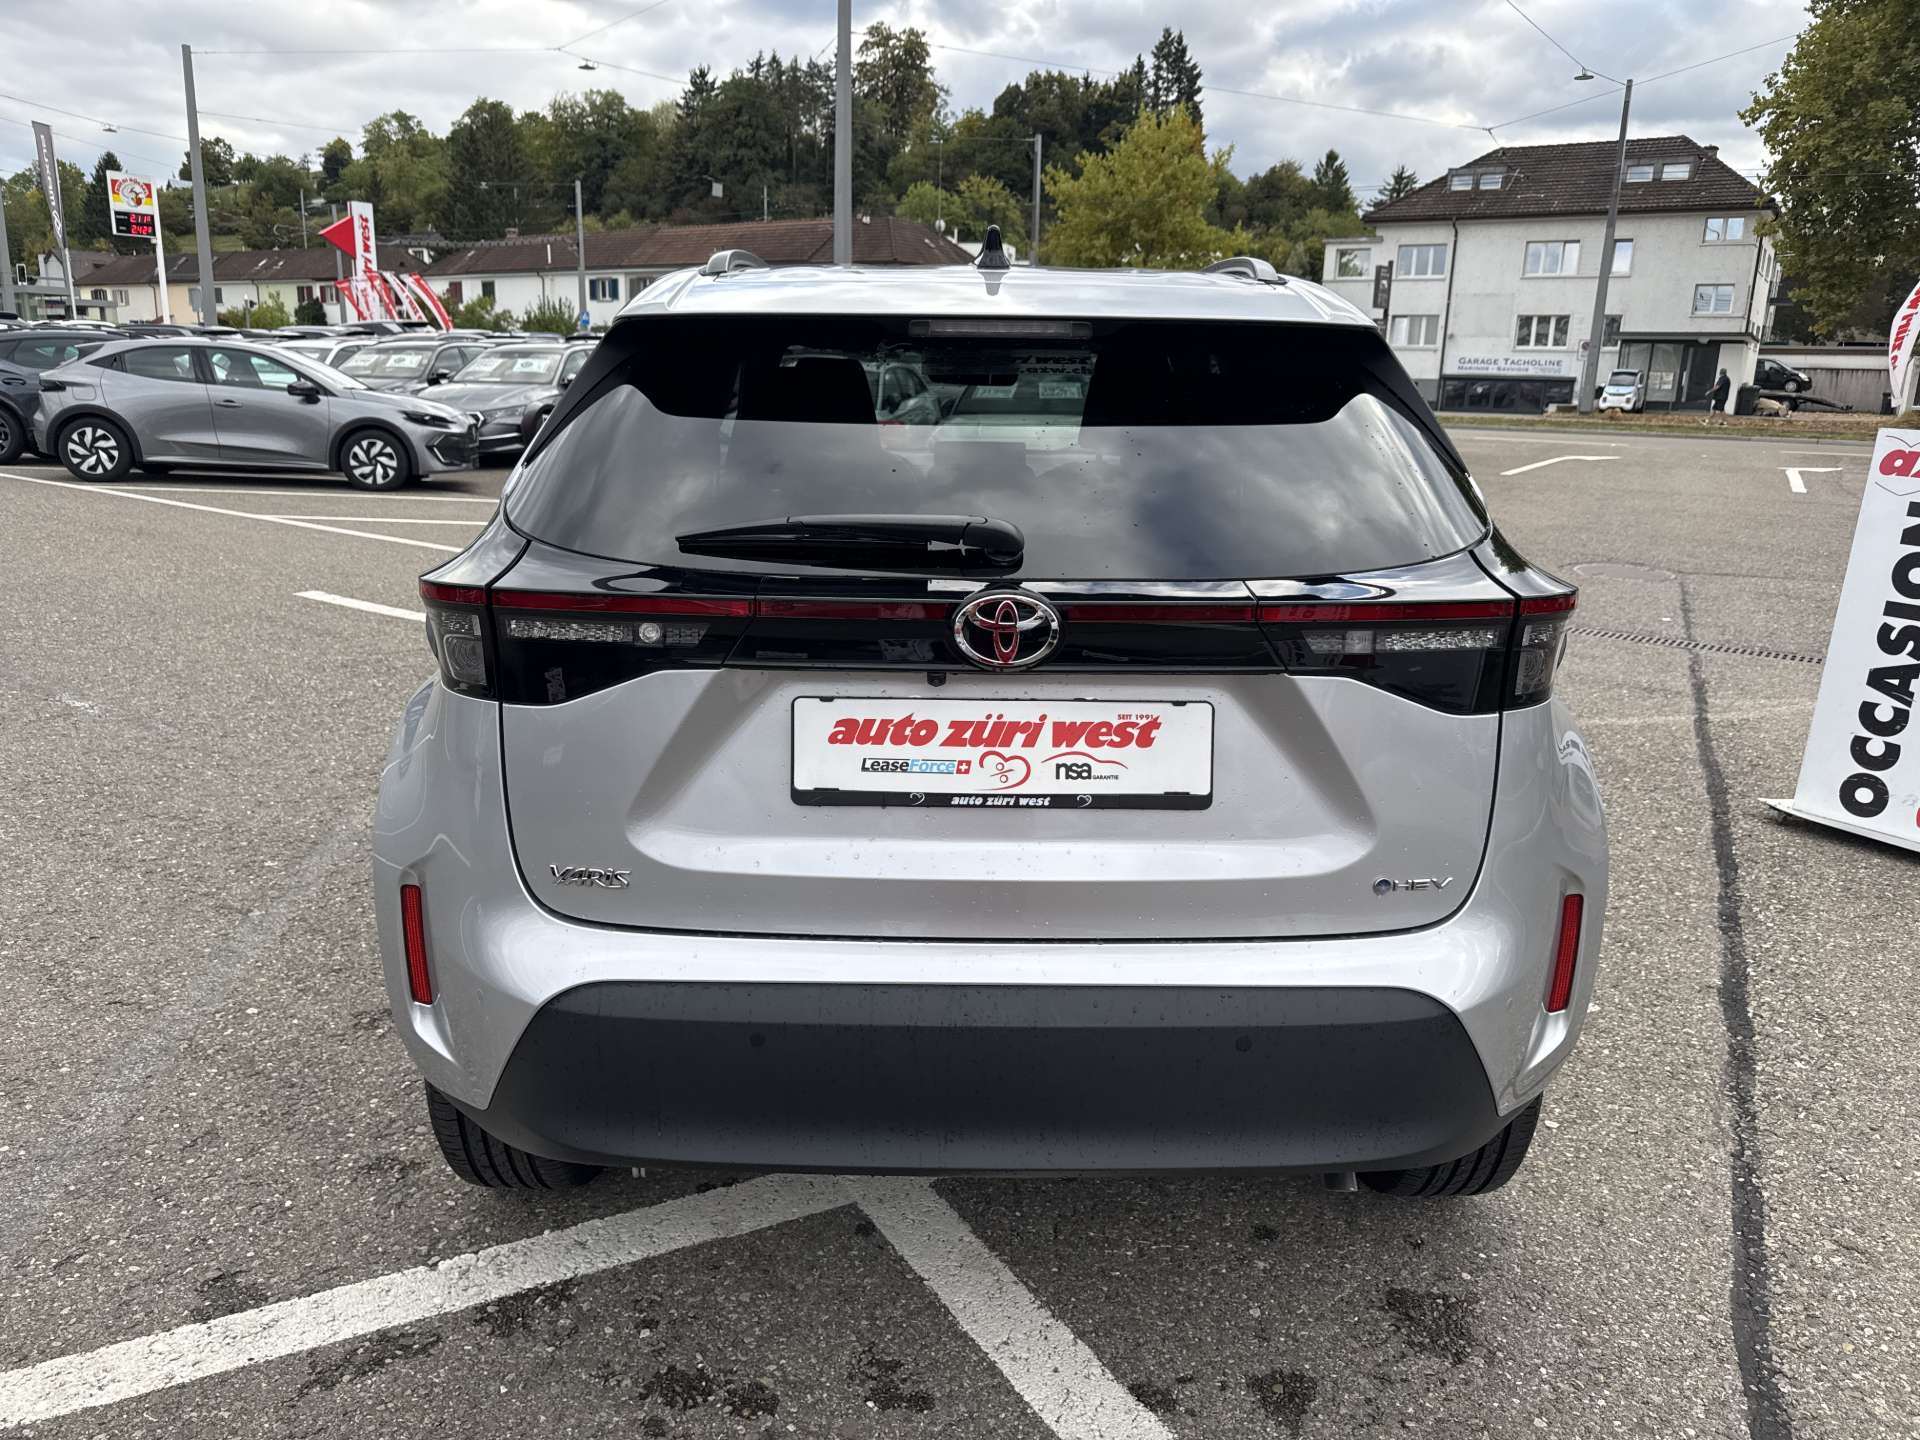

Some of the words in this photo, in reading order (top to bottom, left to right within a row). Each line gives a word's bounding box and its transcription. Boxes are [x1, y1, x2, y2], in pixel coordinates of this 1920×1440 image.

[1458, 357, 1499, 365] GARAGE
[1503, 357, 1563, 367] TACHOLINE
[1839, 501, 1920, 818] OCCASIO
[827, 713, 939, 747] auto
[939, 713, 1048, 748] züri
[1051, 714, 1162, 749] west
[861, 758, 956, 773] LeaseForce
[1055, 762, 1092, 780] nsa
[950, 796, 983, 806] auto
[984, 795, 1016, 807] züri
[1018, 796, 1051, 807] west
[1392, 877, 1454, 892] HEV
